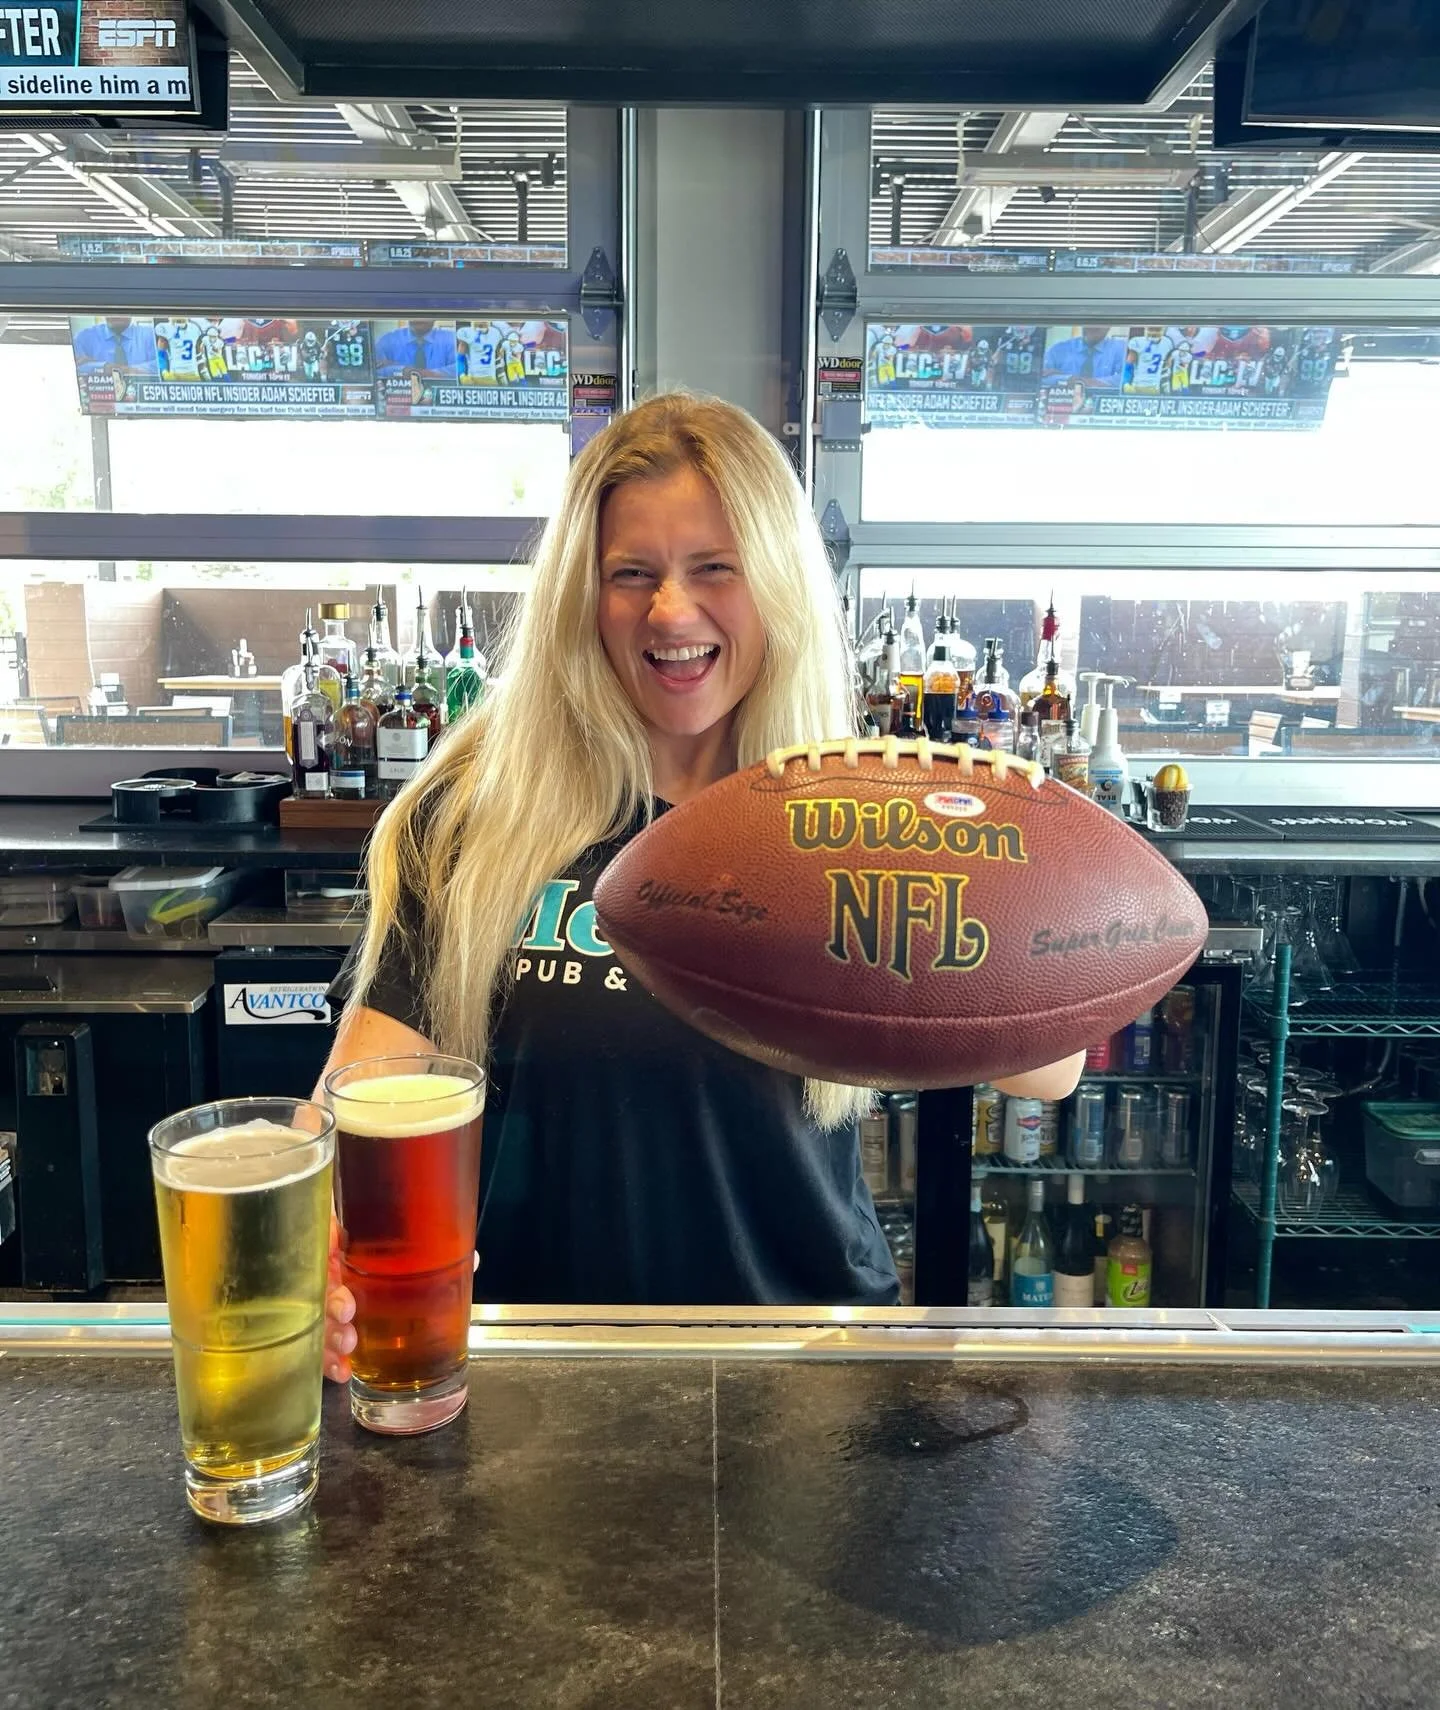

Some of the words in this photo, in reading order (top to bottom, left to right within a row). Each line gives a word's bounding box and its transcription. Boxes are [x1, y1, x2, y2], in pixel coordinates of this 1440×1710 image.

[98, 19, 176, 48] ESPN
[8, 75, 93, 94] sideline
[100, 75, 139, 94] him
[147, 79, 160, 94] a
[167, 79, 187, 94] m
[182, 340, 193, 361] 3
[480, 344, 493, 365] 3
[88, 376, 114, 384] ADAM
[142, 385, 167, 401] ESPN
[168, 386, 203, 401] SENIOR
[204, 386, 222, 401] NFL
[223, 386, 260, 402] INSIDER
[261, 387, 287, 402] ADAM
[288, 387, 335, 402] SCHEFTER
[440, 389, 464, 404] ESPN
[465, 389, 498, 405] SENIOR
[500, 390, 517, 405] NFL
[518, 390, 554, 406] INSIDER
[556, 391, 567, 406] AD
[924, 394, 949, 409] ADAM
[950, 395, 997, 411] SCHEFTER
[785, 797, 1028, 863] Wilson
[824, 869, 990, 984] NFL
[1029, 927, 1100, 960] Super
[515, 958, 583, 985] PUB
[604, 966, 627, 991] &
[228, 987, 326, 1016] AVANTCO
